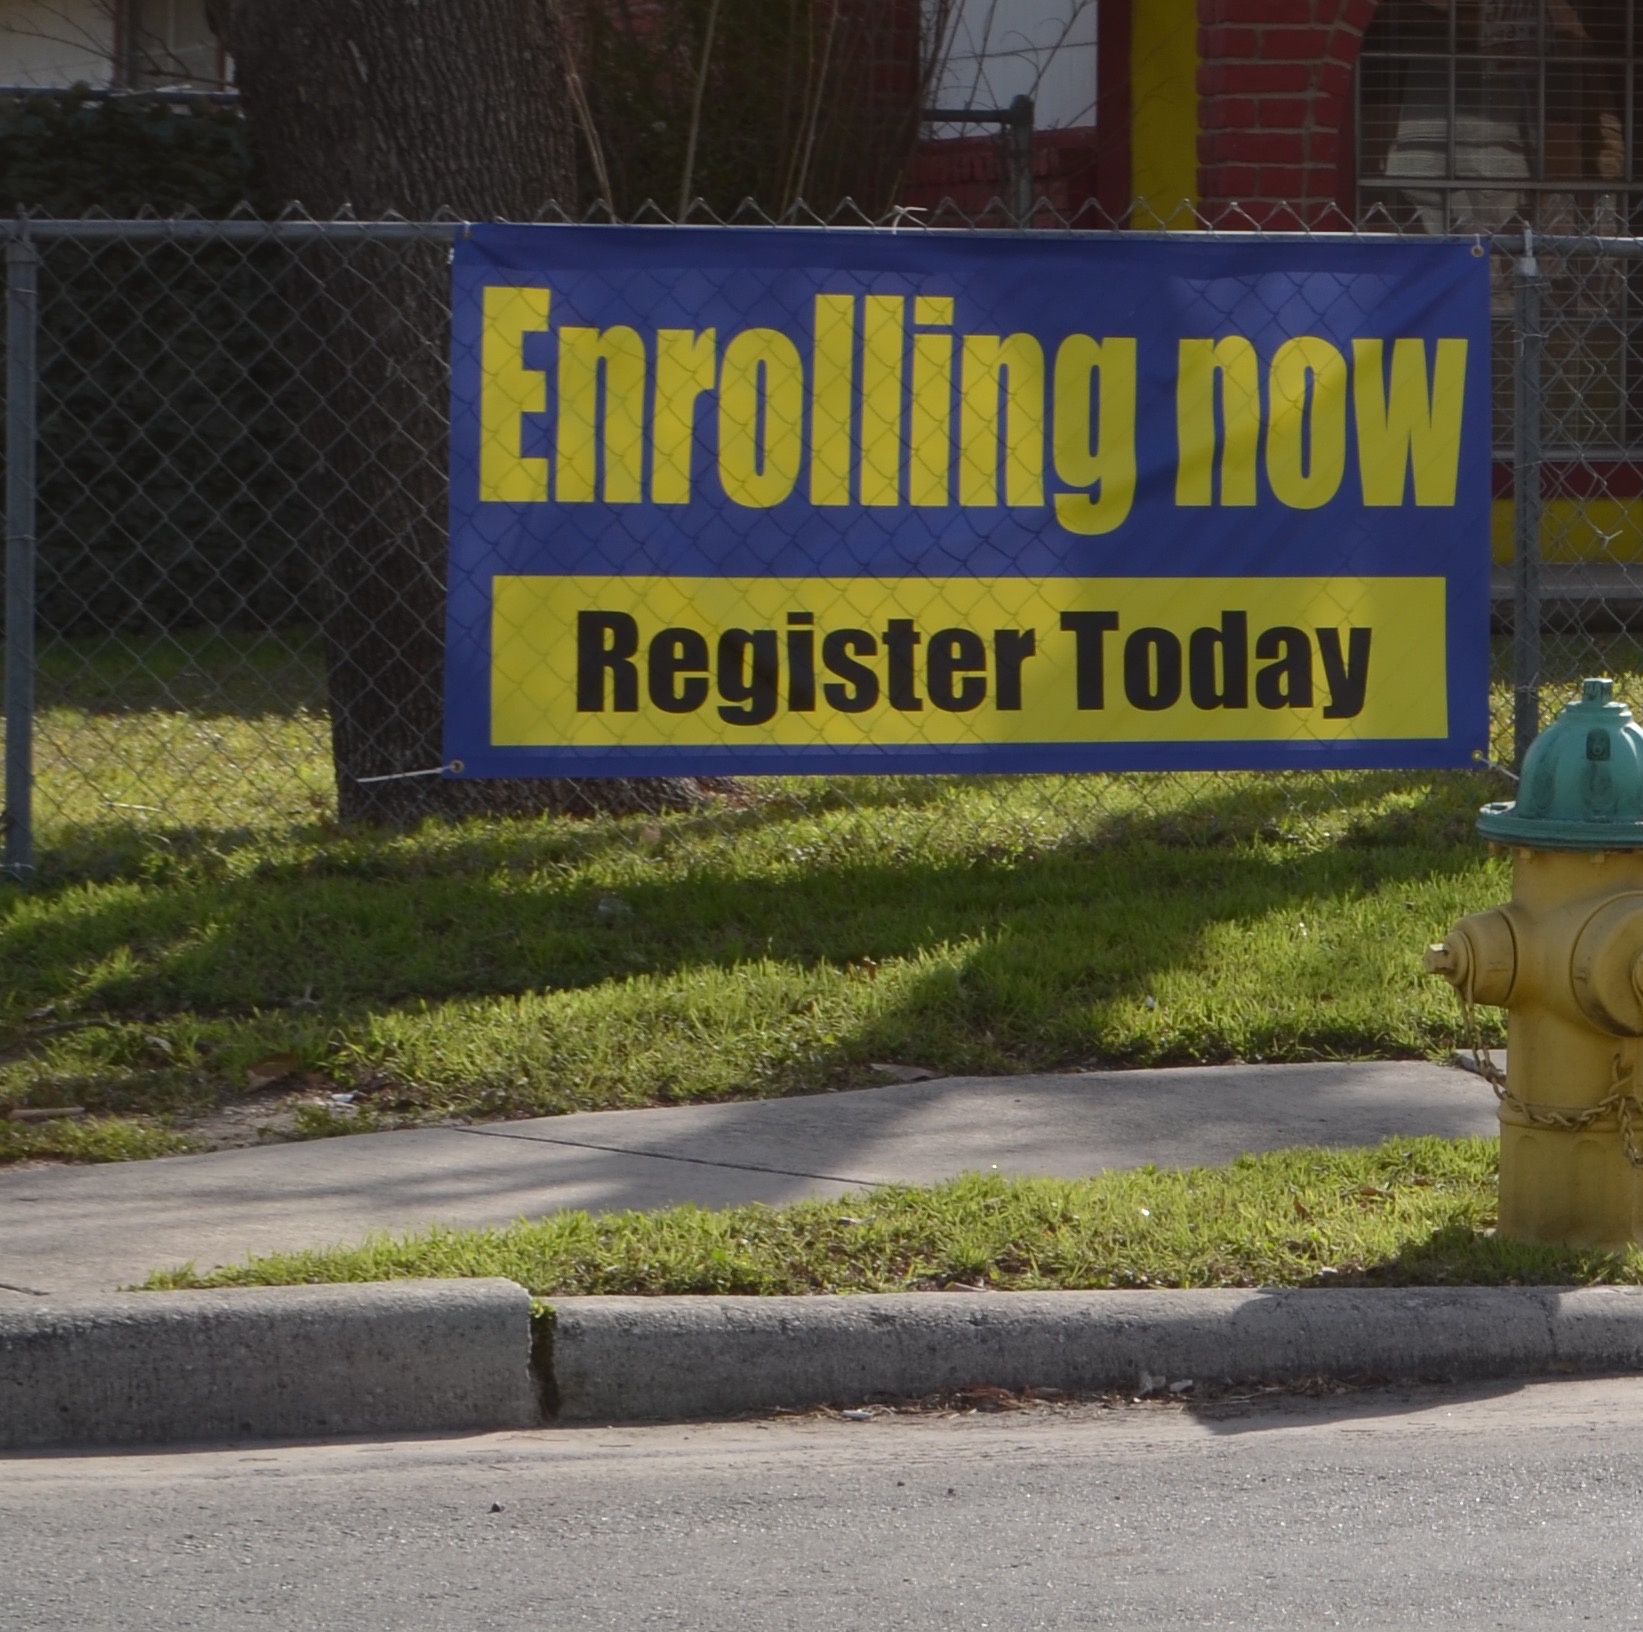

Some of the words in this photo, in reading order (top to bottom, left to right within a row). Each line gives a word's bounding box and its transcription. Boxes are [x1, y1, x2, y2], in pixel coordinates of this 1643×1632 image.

[478, 285, 1138, 537] Enrolling
[1175, 335, 1469, 511] now
[575, 610, 1038, 727] Register
[1060, 610, 1373, 721] Today
